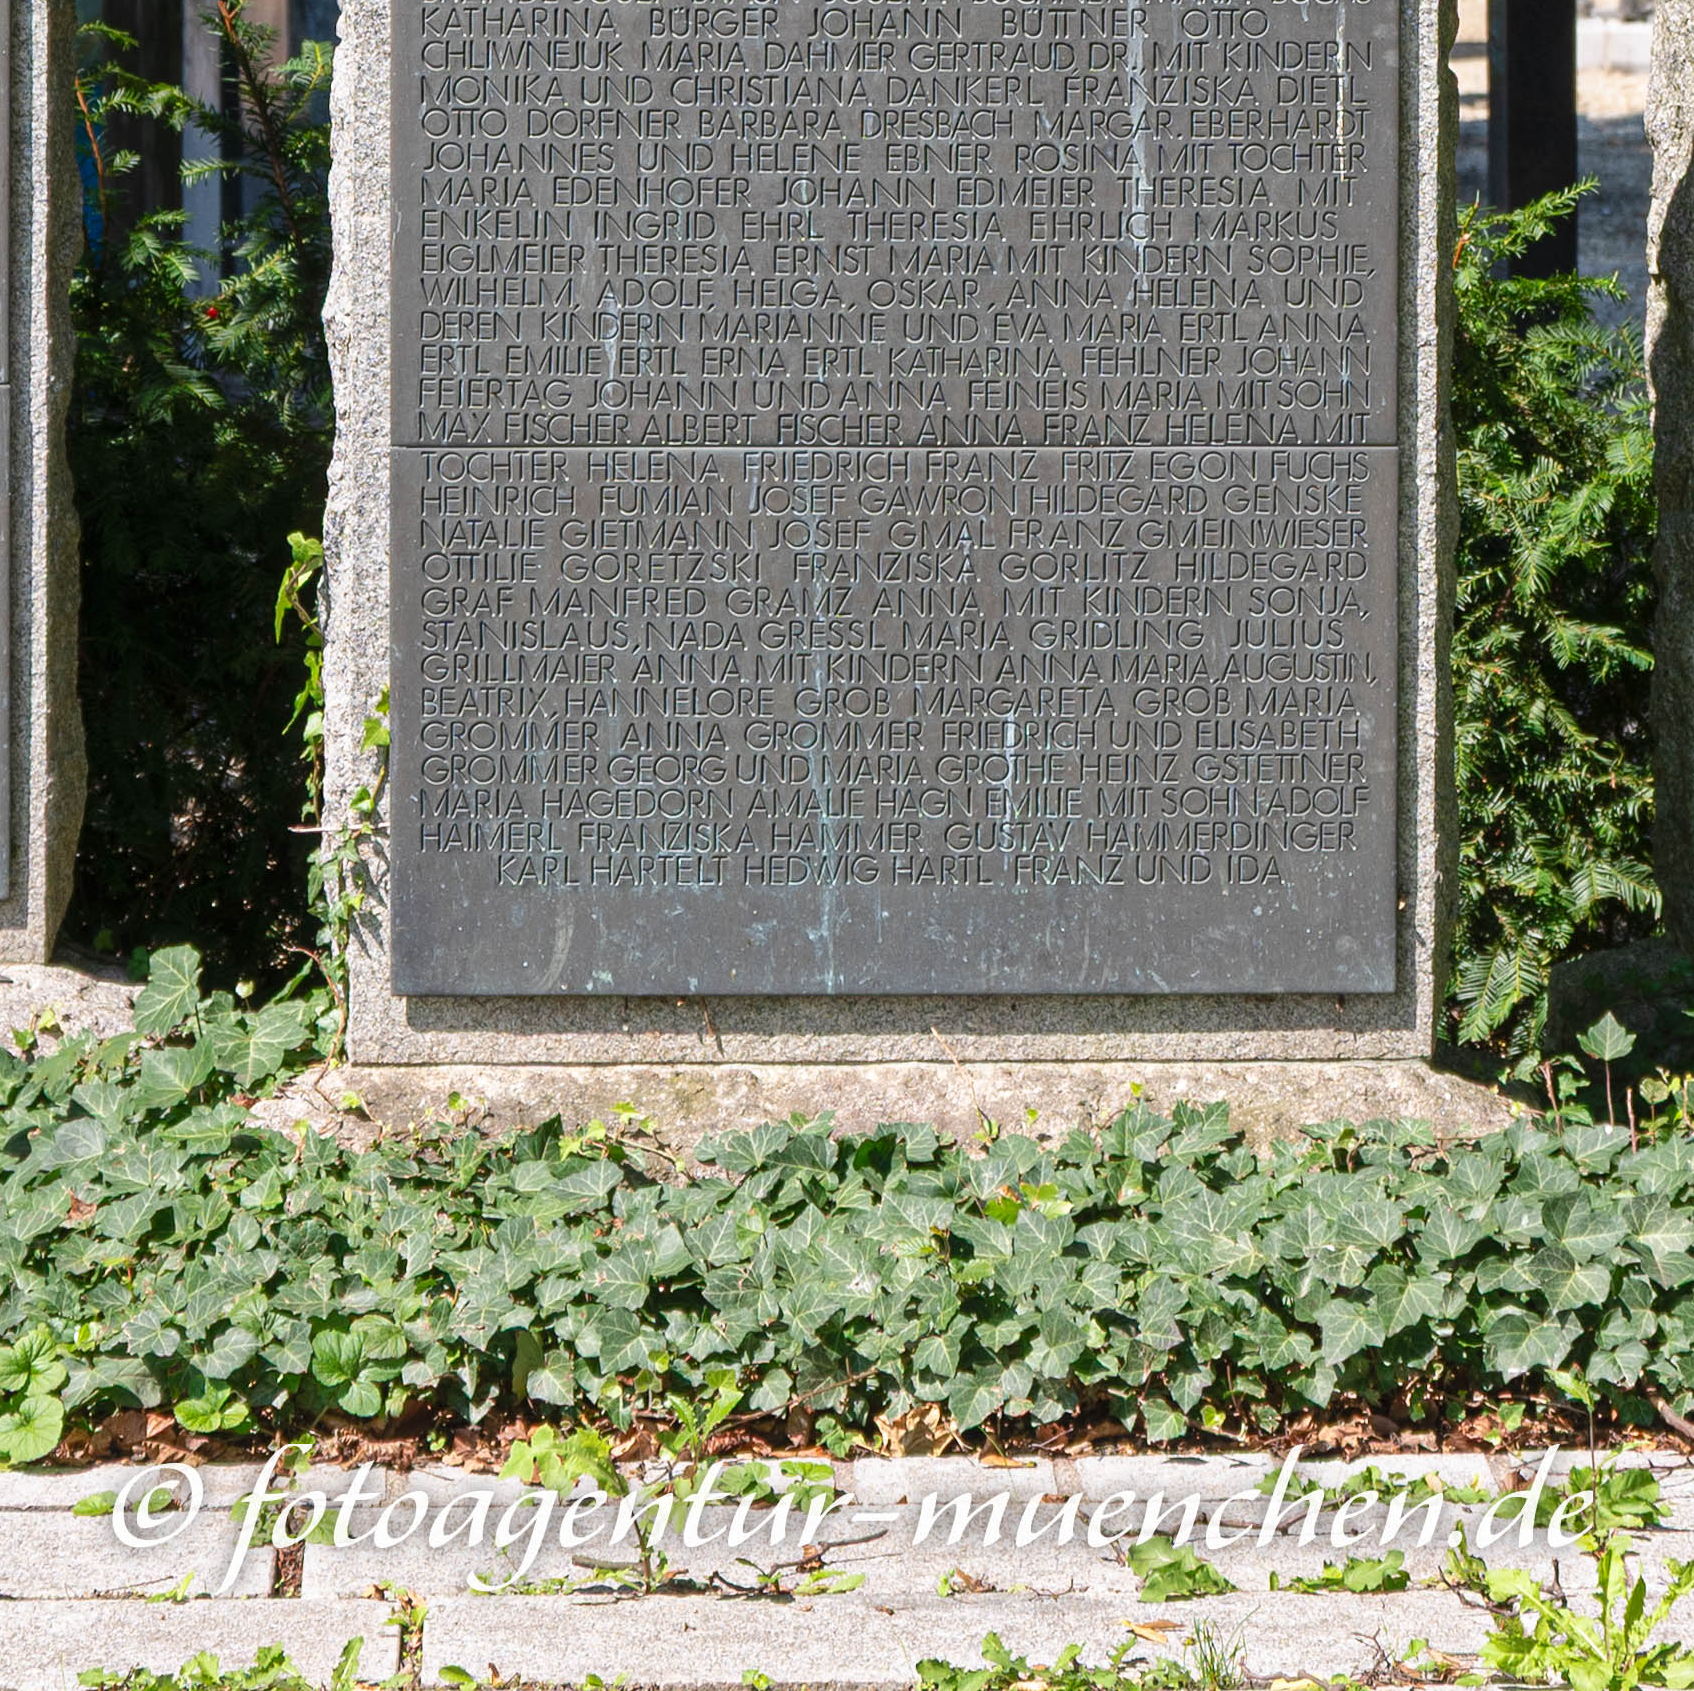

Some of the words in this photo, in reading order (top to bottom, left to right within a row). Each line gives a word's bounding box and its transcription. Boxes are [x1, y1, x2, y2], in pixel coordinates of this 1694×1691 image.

[420, 6, 620, 39] KATHARINA
[649, 7, 780, 39] BÜRGER
[807, 7, 963, 39] JOHANN
[1000, 7, 1149, 39] BÜTTNER
[1180, 7, 1270, 39] OTTO
[420, 210, 572, 242] ENKELIN
[593, 211, 717, 242] INGRID
[741, 211, 825, 242] EHRL
[847, 211, 1007, 242] THERESIA
[1029, 211, 1173, 242] EHRLICH
[1194, 211, 1339, 242] MARKUS
[420, 485, 578, 516] HEINRICH
[599, 485, 734, 516] FUMIAN
[749, 485, 849, 516] JOSEF
[857, 485, 1019, 516] GAWRON
[1029, 484, 1208, 516] HILDEGARD
[1221, 484, 1364, 516] GENSKE
[420, 552, 539, 583] OTTILIE
[793, 551, 982, 583] FRANZISKA
[1175, 551, 1369, 583] HILDEGARD
[496, 855, 581, 886] KARL
[590, 855, 728, 886] HARTELT
[743, 855, 881, 886] HEDWIG
[891, 855, 993, 886] HARTL
[1013, 855, 1127, 886] FRANZ
[1134, 855, 1212, 886] UND
[1227, 855, 1286, 886] IDA
